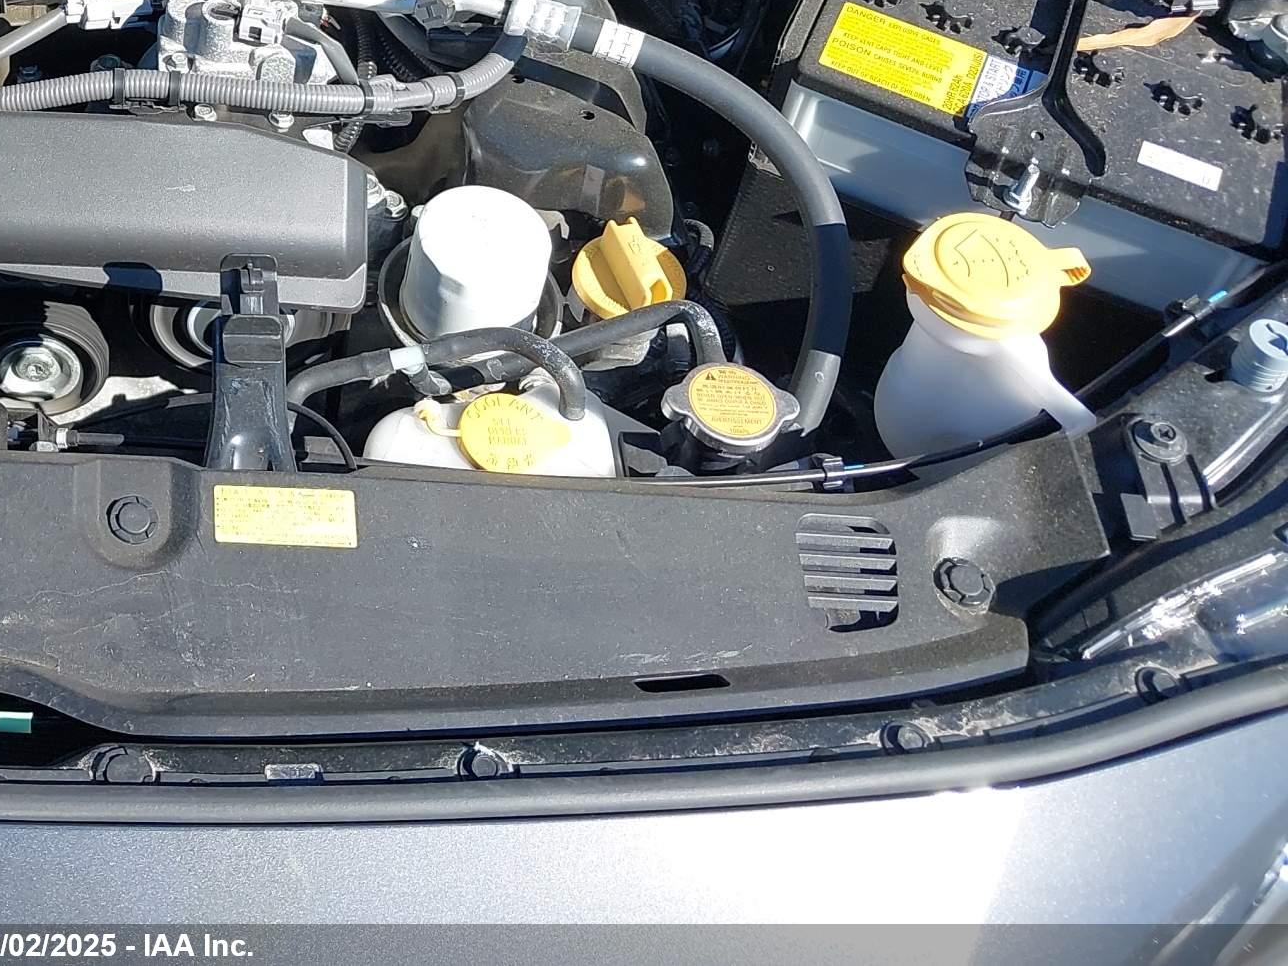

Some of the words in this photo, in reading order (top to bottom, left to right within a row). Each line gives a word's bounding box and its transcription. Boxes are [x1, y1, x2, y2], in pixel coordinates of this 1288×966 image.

[846, 5, 885, 24] DANGER
[888, 22, 920, 37] EXPLOSIVE
[923, 35, 941, 45] GASES
[831, 37, 871, 57] POISON
[874, 54, 898, 67] CAUSES
[899, 64, 922, 76] SEVERE
[924, 73, 946, 85] BURNS
[843, 33, 857, 41] KEEP
[860, 39, 874, 48] VENT
[876, 45, 892, 54] CAPS
[894, 52, 912, 62] TIGHT
[913, 59, 926, 67] AND
[928, 64, 946, 75] LEVEL
[831, 61, 845, 70] KEEP
[846, 66, 859, 75] OUT
[870, 75, 891, 87] REACH
[902, 87, 935, 104] CHILDREN
